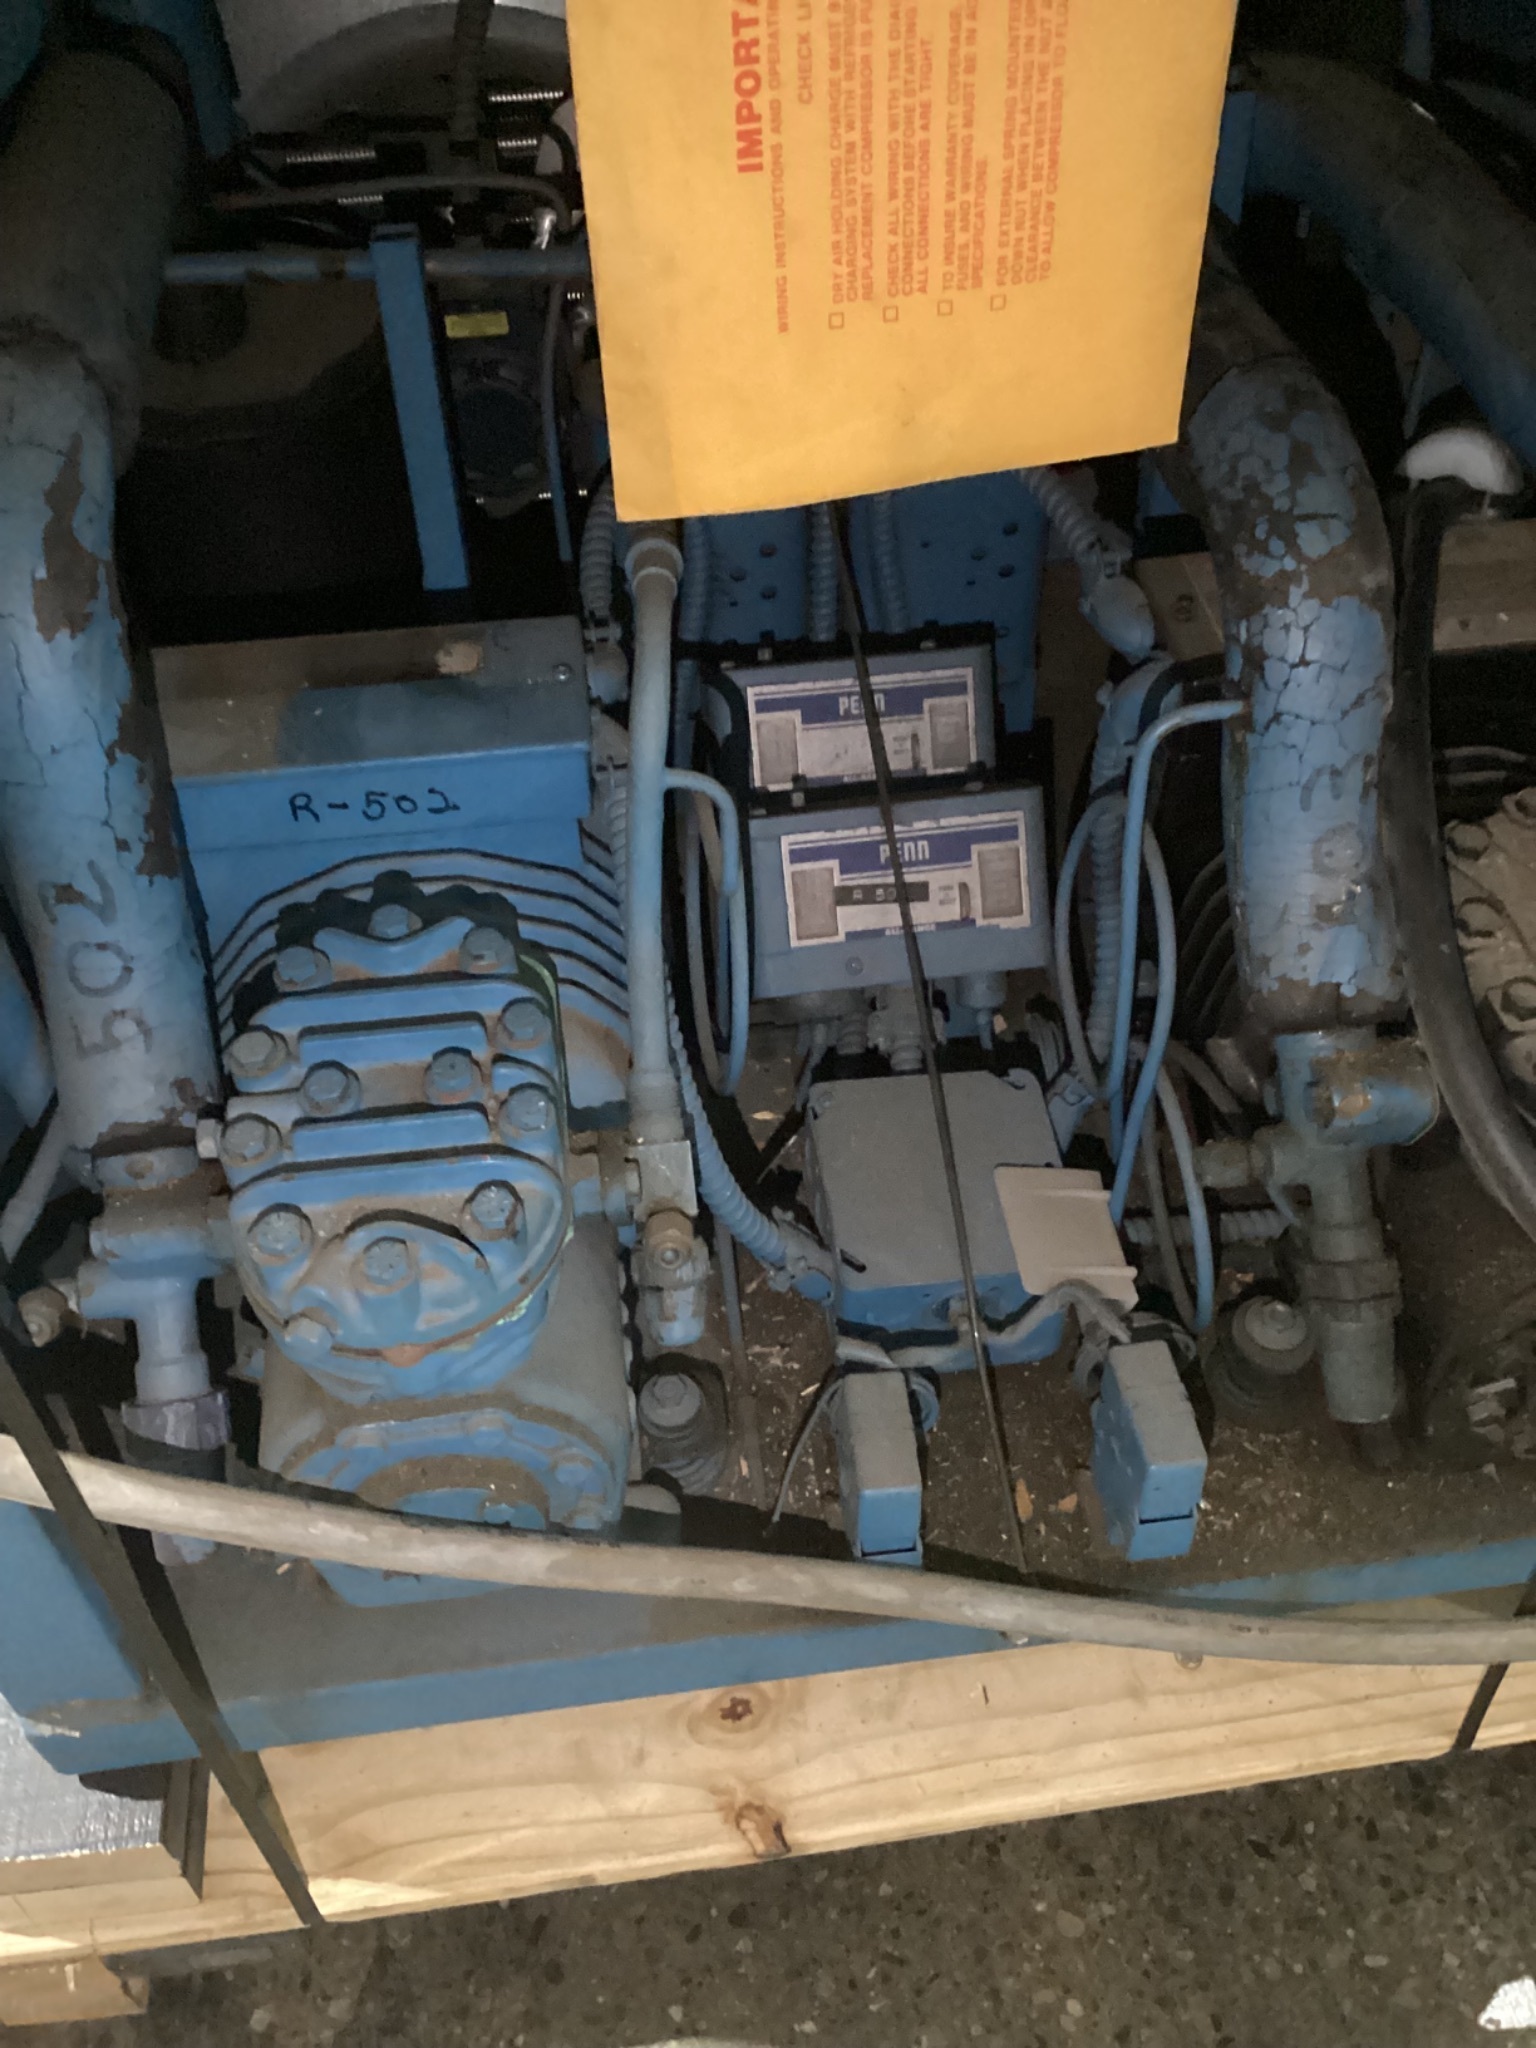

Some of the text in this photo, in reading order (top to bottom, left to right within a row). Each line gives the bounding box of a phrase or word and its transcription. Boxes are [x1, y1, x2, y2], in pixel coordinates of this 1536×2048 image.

[796, 0, 812, 104] CHECK LI
[828, 22, 840, 72] MUST
[1038, 16, 1052, 54] NUT
[1052, 45, 1066, 69] TO
[887, 48, 901, 82] THE
[1036, 61, 1050, 94] THE
[770, 99, 782, 134] AND
[829, 78, 841, 150] CHARGE
[844, 89, 856, 134] WITH
[860, 54, 873, 176] COMPRESSOR
[887, 88, 900, 132] WITH
[918, 99, 932, 132] ARE
[962, 82, 976, 129] MUST
[1019, 59, 1035, 138] PLACING
[902, 6, 918, 297] CONNECTIONS BEFORE STARTING
[1002, 97, 1017, 161] SPRING
[1031, 101, 1048, 183] BETWEEN
[1044, 76, 1066, 195] COMPRESSOR
[844, 141, 856, 208] SYSTEM
[887, 139, 900, 202] WIRING
[944, 112, 958, 204] WARRANTY
[960, 134, 973, 194] WIRING
[1016, 143, 1030, 192] WHEN
[770, 143, 786, 268] INSTRUCTIONS
[830, 157, 842, 234] HOLDING
[888, 207, 899, 236] ALL
[917, 138, 930, 260] CONNECTIONS
[959, 200, 971, 233] AND
[998, 165, 1014, 249] EXTERNAL
[1014, 200, 1027, 232] NUT
[832, 240, 842, 265] AIR
[860, 182, 873, 301] REPLACEMENT
[943, 209, 956, 266] INSURE
[1024, 189, 1042, 283] CLEARANCE
[1041, 201, 1056, 255] ALLOW
[845, 215, 857, 302] CHARGING
[886, 242, 899, 298] CHECK
[916, 266, 928, 294] ALL
[942, 272, 954, 291] TO
[996, 256, 1008, 287] FOR
[1010, 237, 1024, 286] DOWN
[1039, 260, 1051, 281] TO
[776, 276, 788, 334] WIRING
[832, 272, 844, 304] DRY
[838, 692, 886, 717] PEN
[288, 786, 461, 823] R-502
